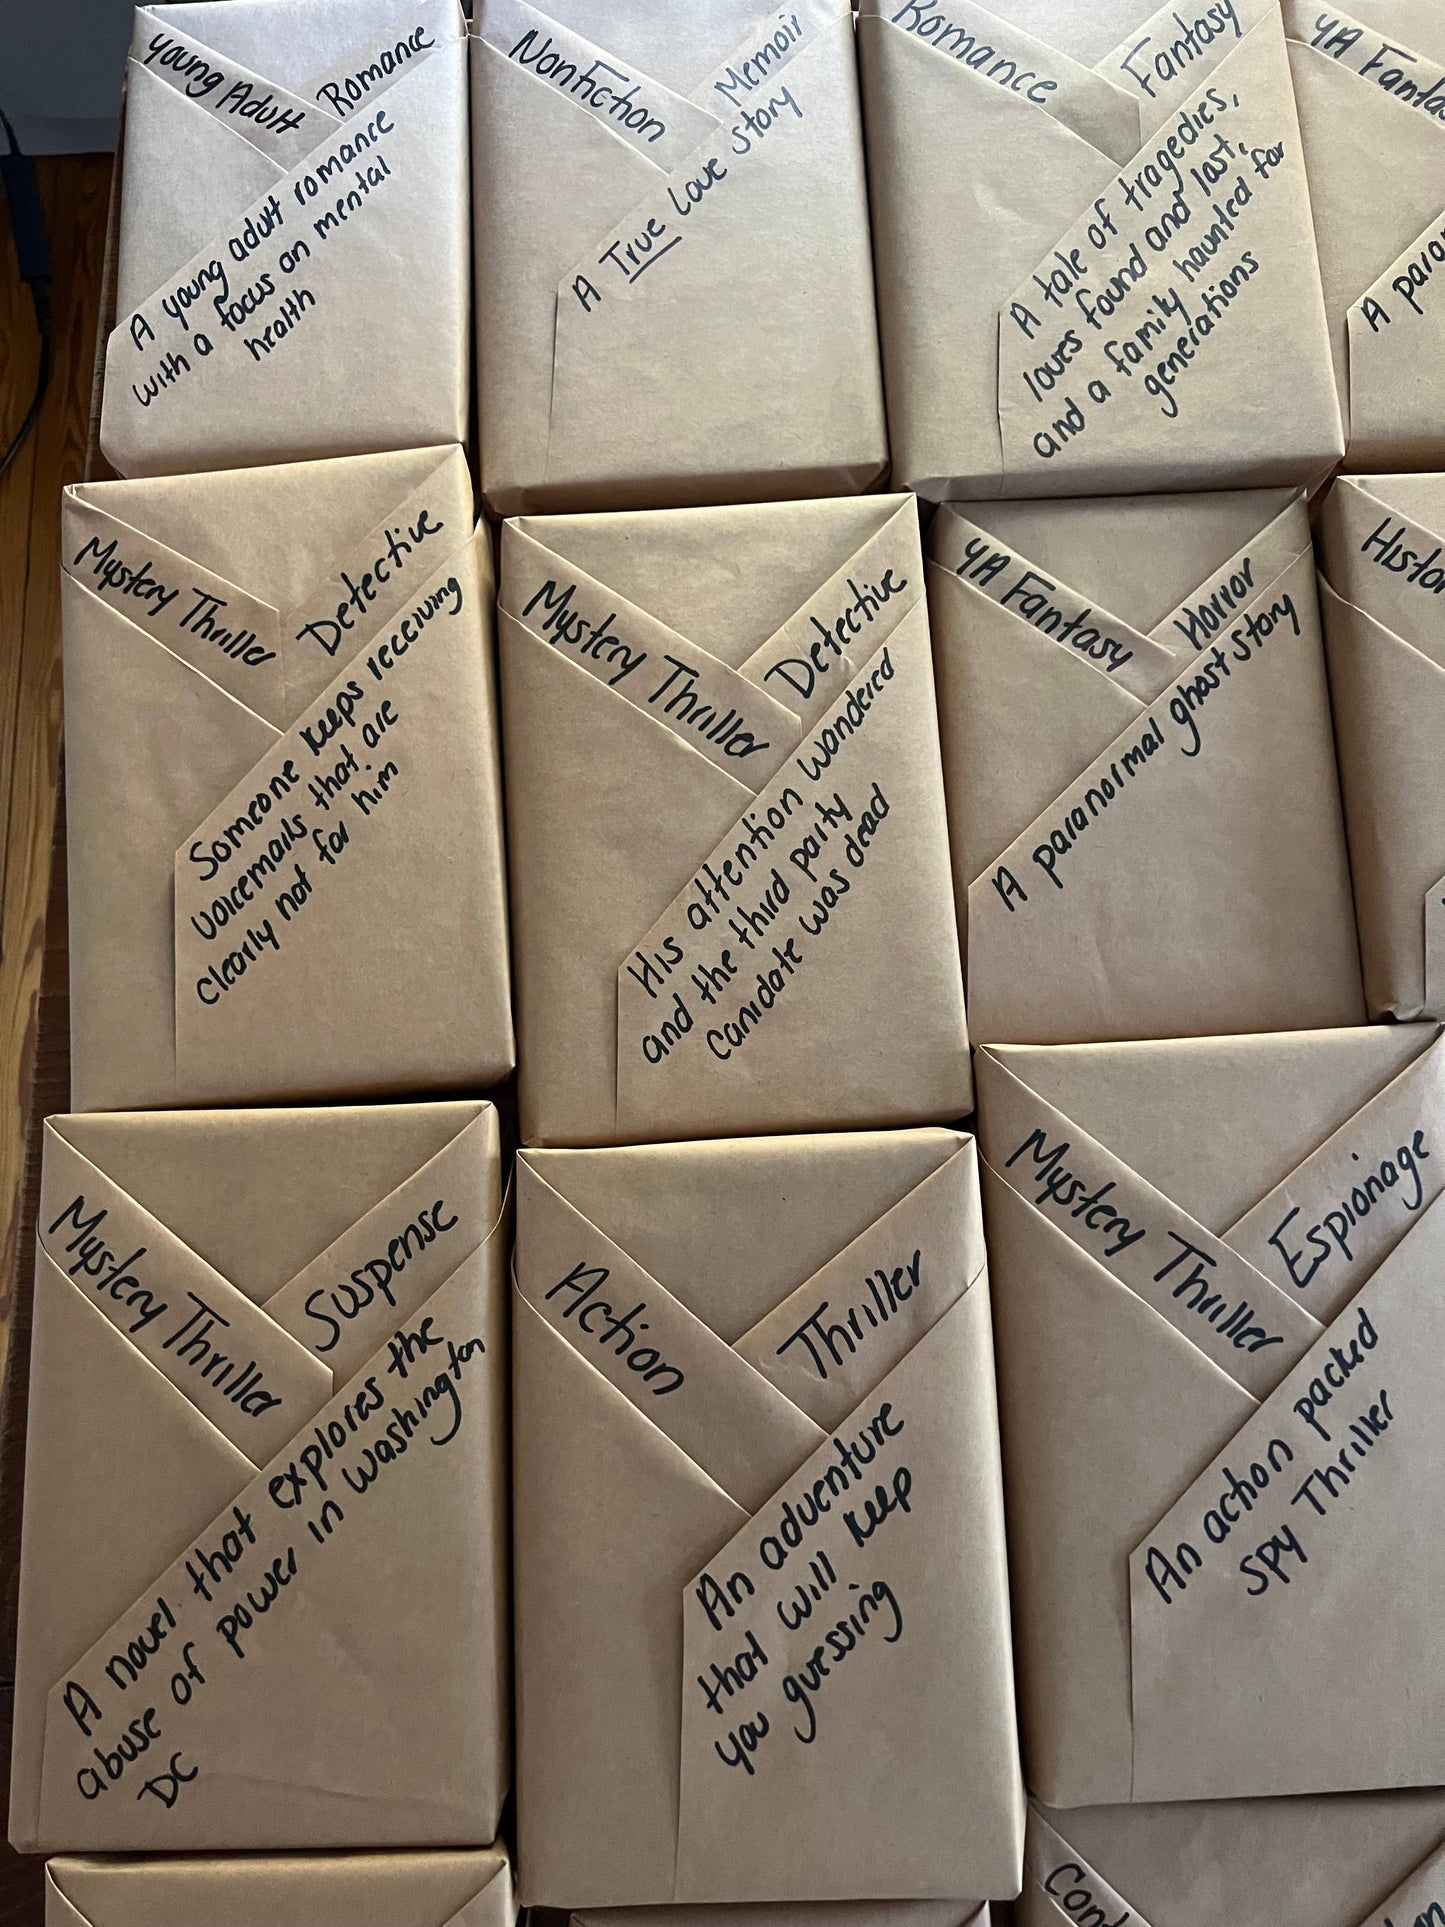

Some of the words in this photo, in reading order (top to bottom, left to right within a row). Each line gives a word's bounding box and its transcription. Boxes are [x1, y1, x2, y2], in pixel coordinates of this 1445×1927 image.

[215, 80, 306, 134] Adult
[317, 25, 435, 117] Romance
[714, 13, 803, 107] Memoir
[891, 0, 1058, 104] Romance
[1120, 0, 1243, 98] Fantasy
[1311, 13, 1365, 58] YA
[1358, 43, 1445, 121] Fanta
[130, 314, 155, 351] A
[162, 260, 228, 330] young
[229, 195, 283, 262] adult
[295, 110, 394, 205] romance
[132, 353, 191, 406] with
[195, 333, 213, 355] a
[213, 273, 276, 331] focus
[280, 240, 310, 273] on
[314, 155, 392, 239] mental
[572, 275, 601, 312] A
[598, 218, 666, 275] True
[1010, 302, 1042, 339] A
[1034, 249, 1087, 308] tale
[1088, 197, 1118, 251] of
[1118, 87, 1240, 212] tragedies,
[1361, 297, 1390, 332] A
[1392, 230, 1445, 314] para
[244, 288, 315, 360] health
[1022, 330, 1082, 402] loves
[1075, 244, 1147, 330] found
[1145, 191, 1192, 252] and
[1034, 403, 1086, 459] and
[1089, 379, 1112, 403] a
[1105, 287, 1194, 377] family
[1173, 177, 1253, 282] haunted
[1145, 251, 1259, 418] generations
[74, 536, 179, 616] Mystery
[180, 589, 276, 667] Thriller
[296, 510, 443, 656] Detective
[764, 569, 907, 699] Detective
[956, 537, 1012, 586] YA
[1000, 571, 1133, 672] Fantasy
[1174, 557, 1256, 650] Horror
[189, 760, 300, 882] Someone
[300, 681, 363, 757] keeps
[367, 576, 463, 682] receiving
[522, 580, 647, 685] Mystery
[648, 655, 770, 758] Thriller
[192, 814, 309, 941] voicemails
[309, 744, 362, 812] that
[363, 700, 399, 749] are
[275, 864, 313, 923] not
[313, 821, 350, 866] for
[351, 760, 399, 815] him
[992, 866, 1027, 912] A
[1032, 716, 1164, 889] paranormal
[1170, 644, 1232, 757] ghost
[628, 936, 683, 998] His
[688, 788, 803, 930] attention
[644, 992, 694, 1064] and
[691, 949, 738, 1005] the
[729, 869, 790, 949] third
[790, 794, 852, 883] party
[799, 868, 850, 935] was
[846, 783, 890, 867] dead
[305, 1200, 458, 1351] Suspense
[1005, 1128, 1145, 1257] Mystery
[1154, 1230, 1283, 1352] Thriller
[1268, 1129, 1429, 1288] Espionage
[48, 1195, 168, 1332] Mystery
[162, 1292, 282, 1418] Thriller
[545, 1261, 684, 1396] Action
[776, 1250, 922, 1379] Thriller
[62, 1681, 102, 1736] A
[107, 1597, 175, 1688] novel
[186, 1506, 257, 1603] that
[269, 1376, 384, 1508] explores
[386, 1317, 443, 1378] the
[696, 1571, 754, 1630] An
[759, 1402, 904, 1570] adventure
[1145, 1542, 1202, 1604] An
[1203, 1439, 1294, 1544] action
[1294, 1307, 1378, 1441] packed
[1291, 1390, 1393, 1515] Thriller
[77, 1708, 161, 1799] abuse
[171, 1642, 206, 1705] of
[217, 1548, 297, 1658] power
[309, 1503, 343, 1544] in
[697, 1630, 768, 1715] that
[777, 1551, 837, 1631] will
[843, 1466, 912, 1547] keep
[715, 1710, 769, 1775] you
[782, 1580, 902, 1743] guessing
[138, 1752, 199, 1808] DC
